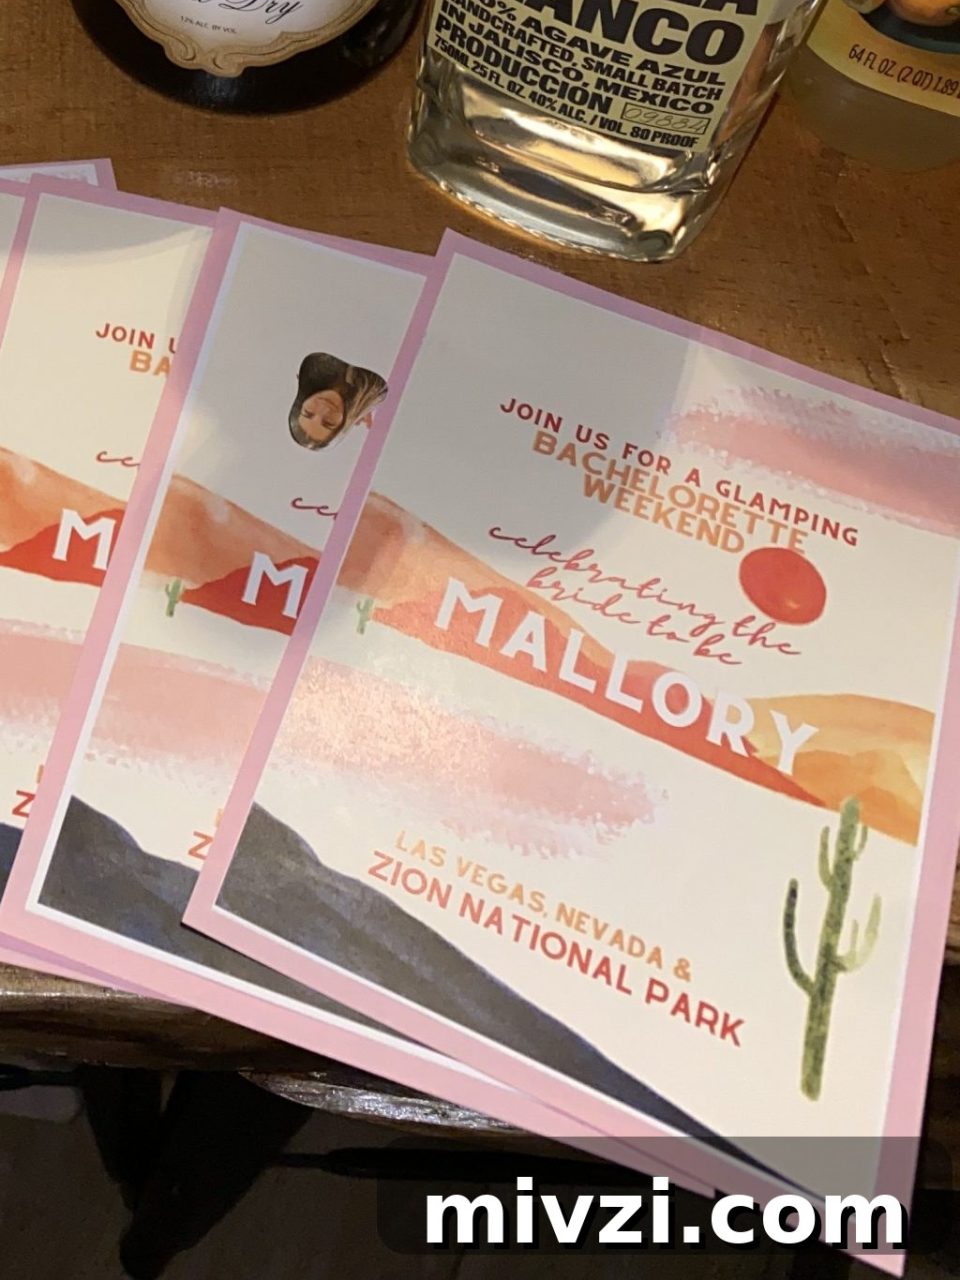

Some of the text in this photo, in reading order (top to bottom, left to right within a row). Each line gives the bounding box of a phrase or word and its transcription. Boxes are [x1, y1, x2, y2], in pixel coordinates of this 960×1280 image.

[433, 33, 472, 72] 750ML
[470, 59, 491, 78] 25
[528, 90, 559, 112] 40%
[557, 103, 588, 125] ALC.
[629, 123, 651, 142] 80
[649, 128, 700, 149] PROOF
[520, 16, 635, 67] AGAVE
[634, 58, 728, 87] AZUL
[581, 55, 650, 90] SMALL
[650, 75, 725, 102] BATCH
[594, 77, 716, 116] MEXICO
[848, 43, 866, 63] 64
[863, 51, 878, 70] FL
[878, 58, 897, 77] OZ
[95, 322, 155, 352] JOIN
[500, 397, 859, 547] JOIN US FOR A GLAMPING
[531, 430, 809, 556] BACHELORETTE
[583, 473, 746, 554] WEEKEND
[488, 525, 802, 656] celebrating the
[525, 567, 744, 666] bride to be
[434, 575, 820, 777] MALLORY
[368, 850, 745, 1047] ZION NATIONAL PARK
[395, 830, 693, 981] LAS VEGAS, NEVADA &
